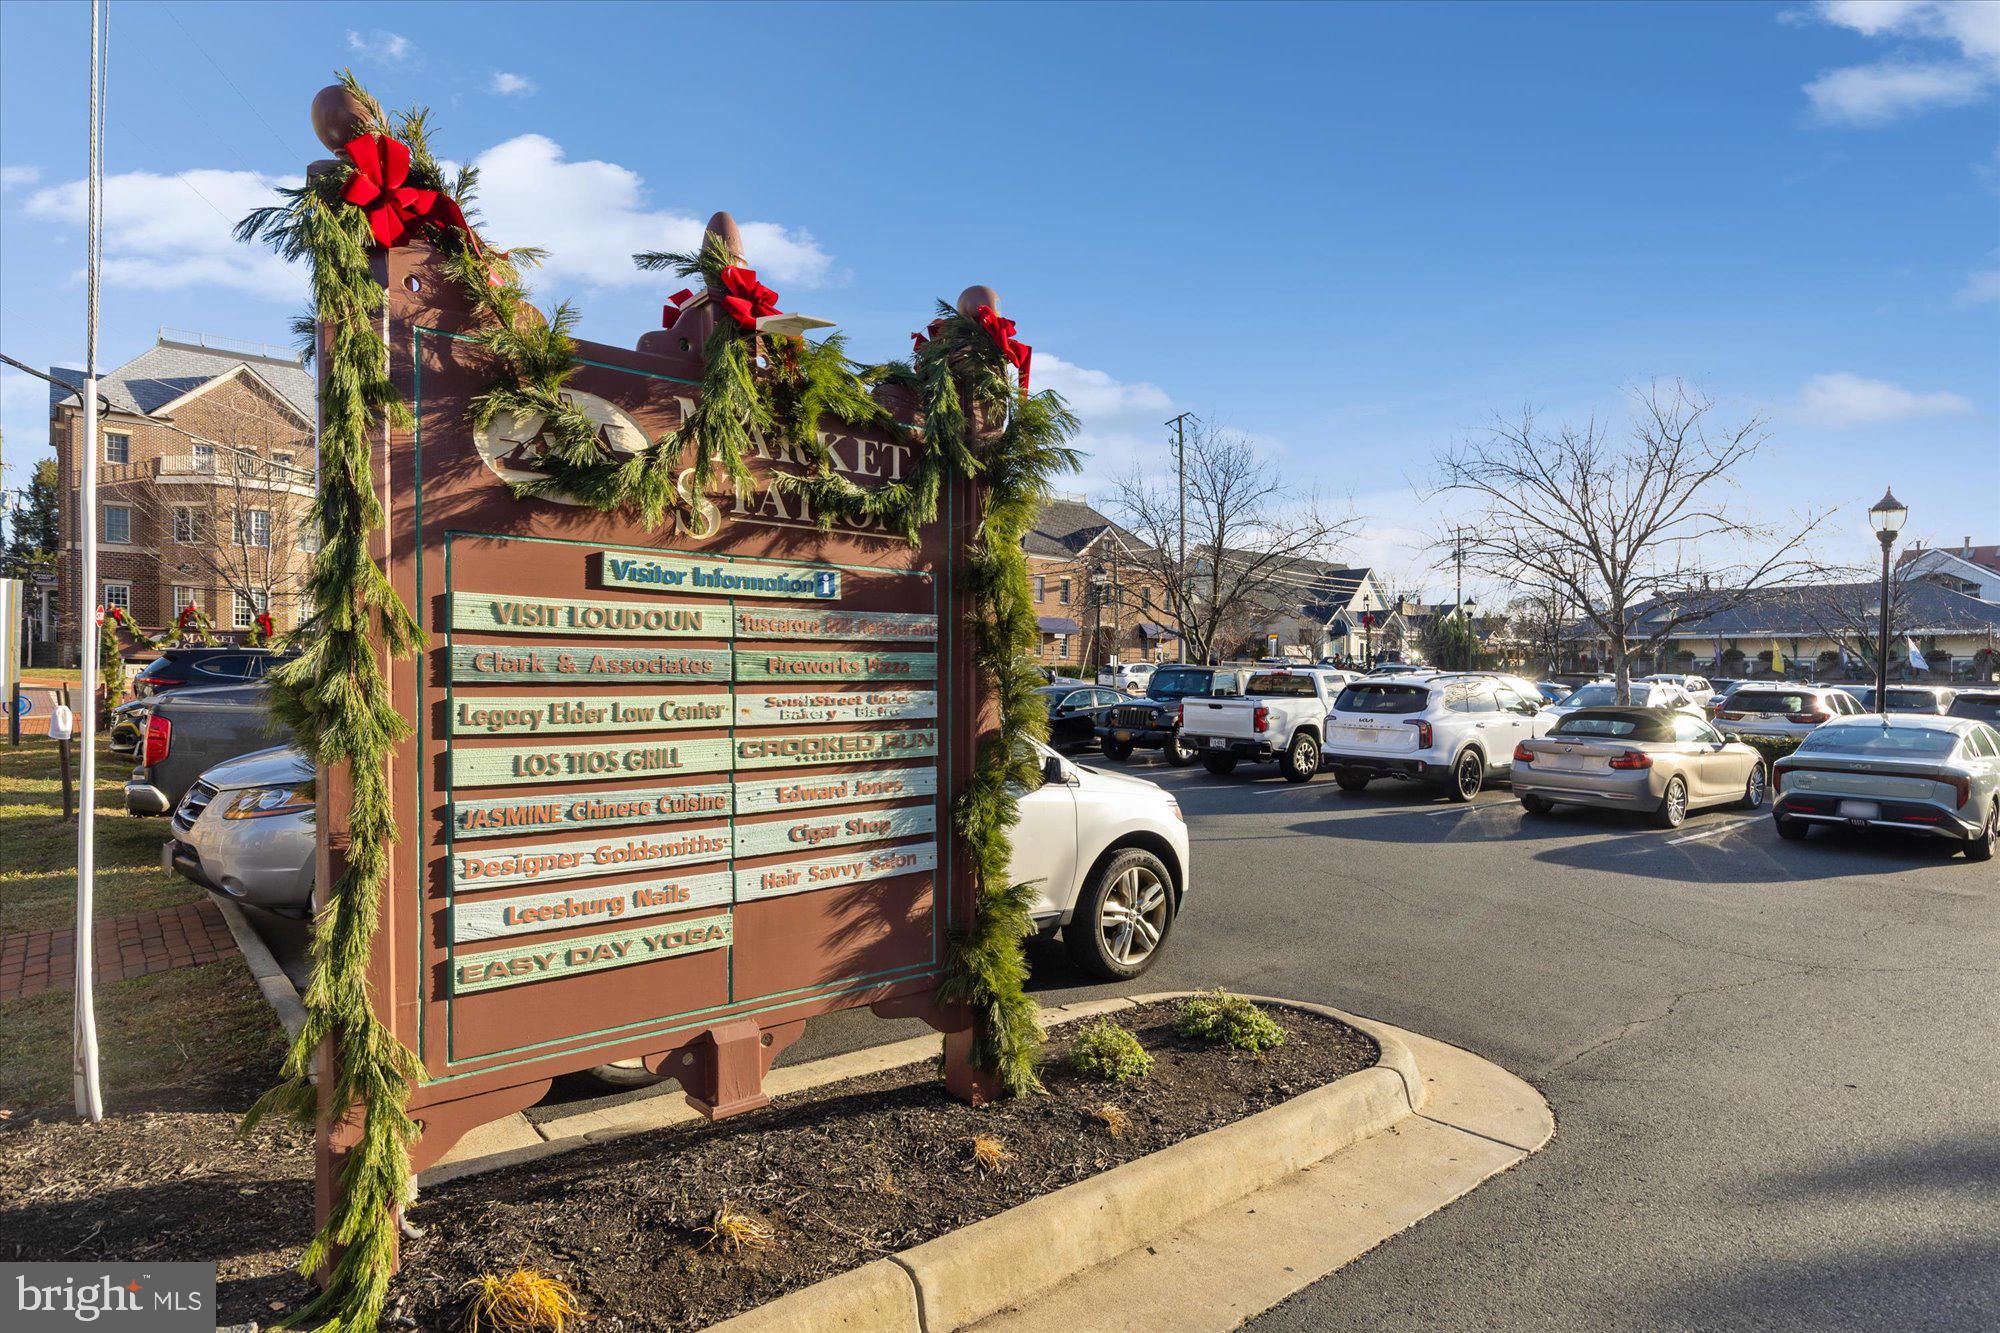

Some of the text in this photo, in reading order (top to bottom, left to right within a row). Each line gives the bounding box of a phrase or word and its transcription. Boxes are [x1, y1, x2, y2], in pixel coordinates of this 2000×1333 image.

[675, 467, 890, 539] STAO
[609, 559, 687, 585] Visitor
[692, 566, 814, 593] Information
[492, 599, 703, 631] VISIT LOUDOUN
[741, 614, 820, 634] Tuscarora
[182, 633, 236, 644] MAKET
[475, 651, 713, 674] Clark & Associates
[767, 656, 910, 674] Fireworks Pizza
[461, 700, 726, 731] Legacy Elder Law Center
[738, 735, 875, 759] CROOKED
[882, 732, 935, 750] RUN
[513, 747, 684, 777] LOS TIOS GRILL
[777, 779, 904, 803] Edward Jones
[461, 792, 726, 829] JASMINE Chinese Cuisine
[788, 818, 892, 844] Cigar Shop
[463, 835, 725, 880] Designer Goldsmiths
[761, 852, 917, 890] Hair Savvy Salon
[505, 885, 691, 926] Leesburg Nails
[459, 924, 727, 984] EASY DAY YOGA
